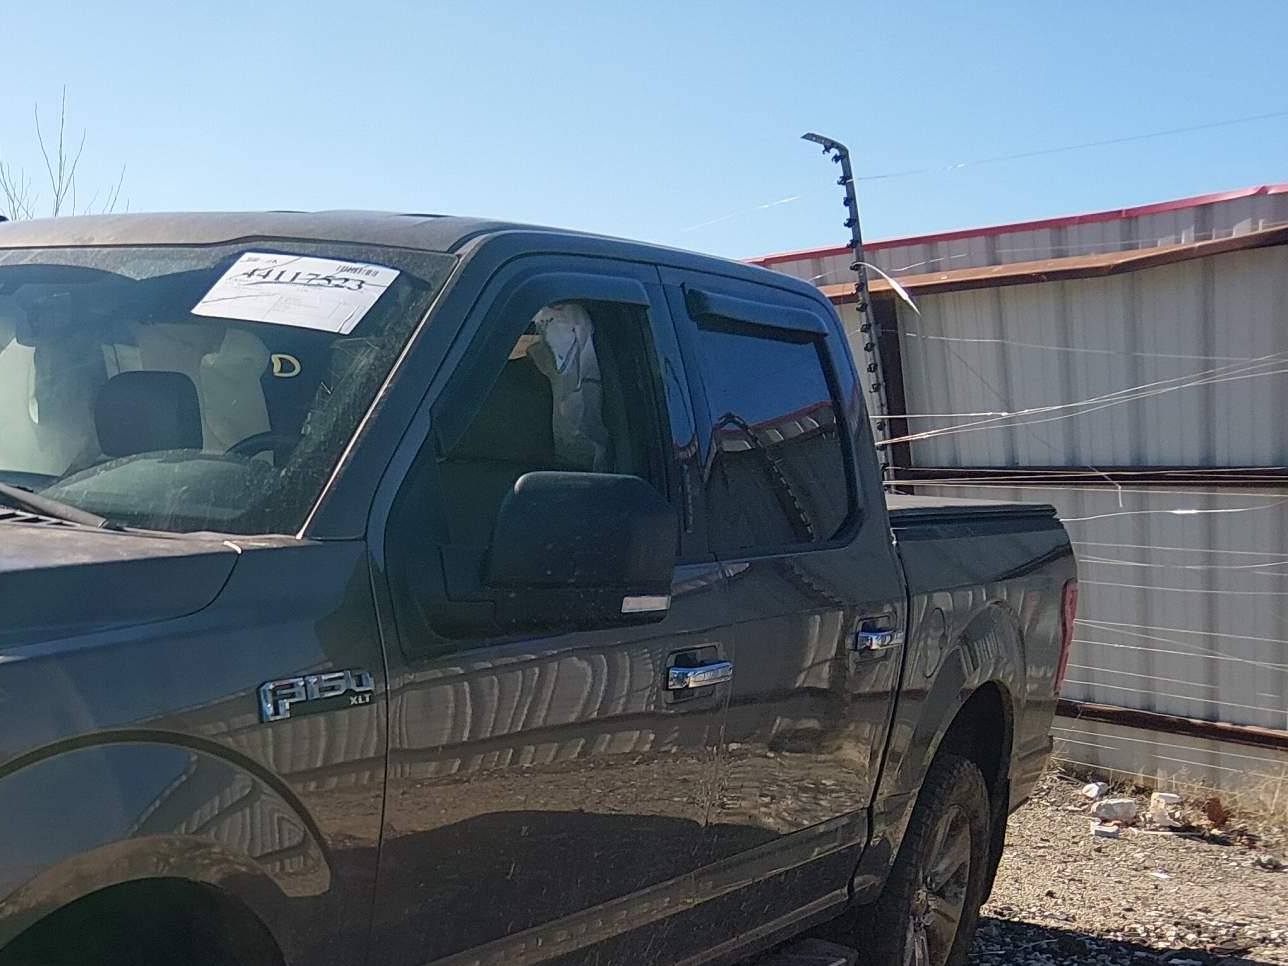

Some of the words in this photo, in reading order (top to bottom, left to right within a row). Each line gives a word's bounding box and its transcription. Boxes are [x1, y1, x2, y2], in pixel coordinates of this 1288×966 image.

[240, 268, 365, 291] 44117523
[271, 354, 302, 377] D
[349, 693, 372, 705] XLT
